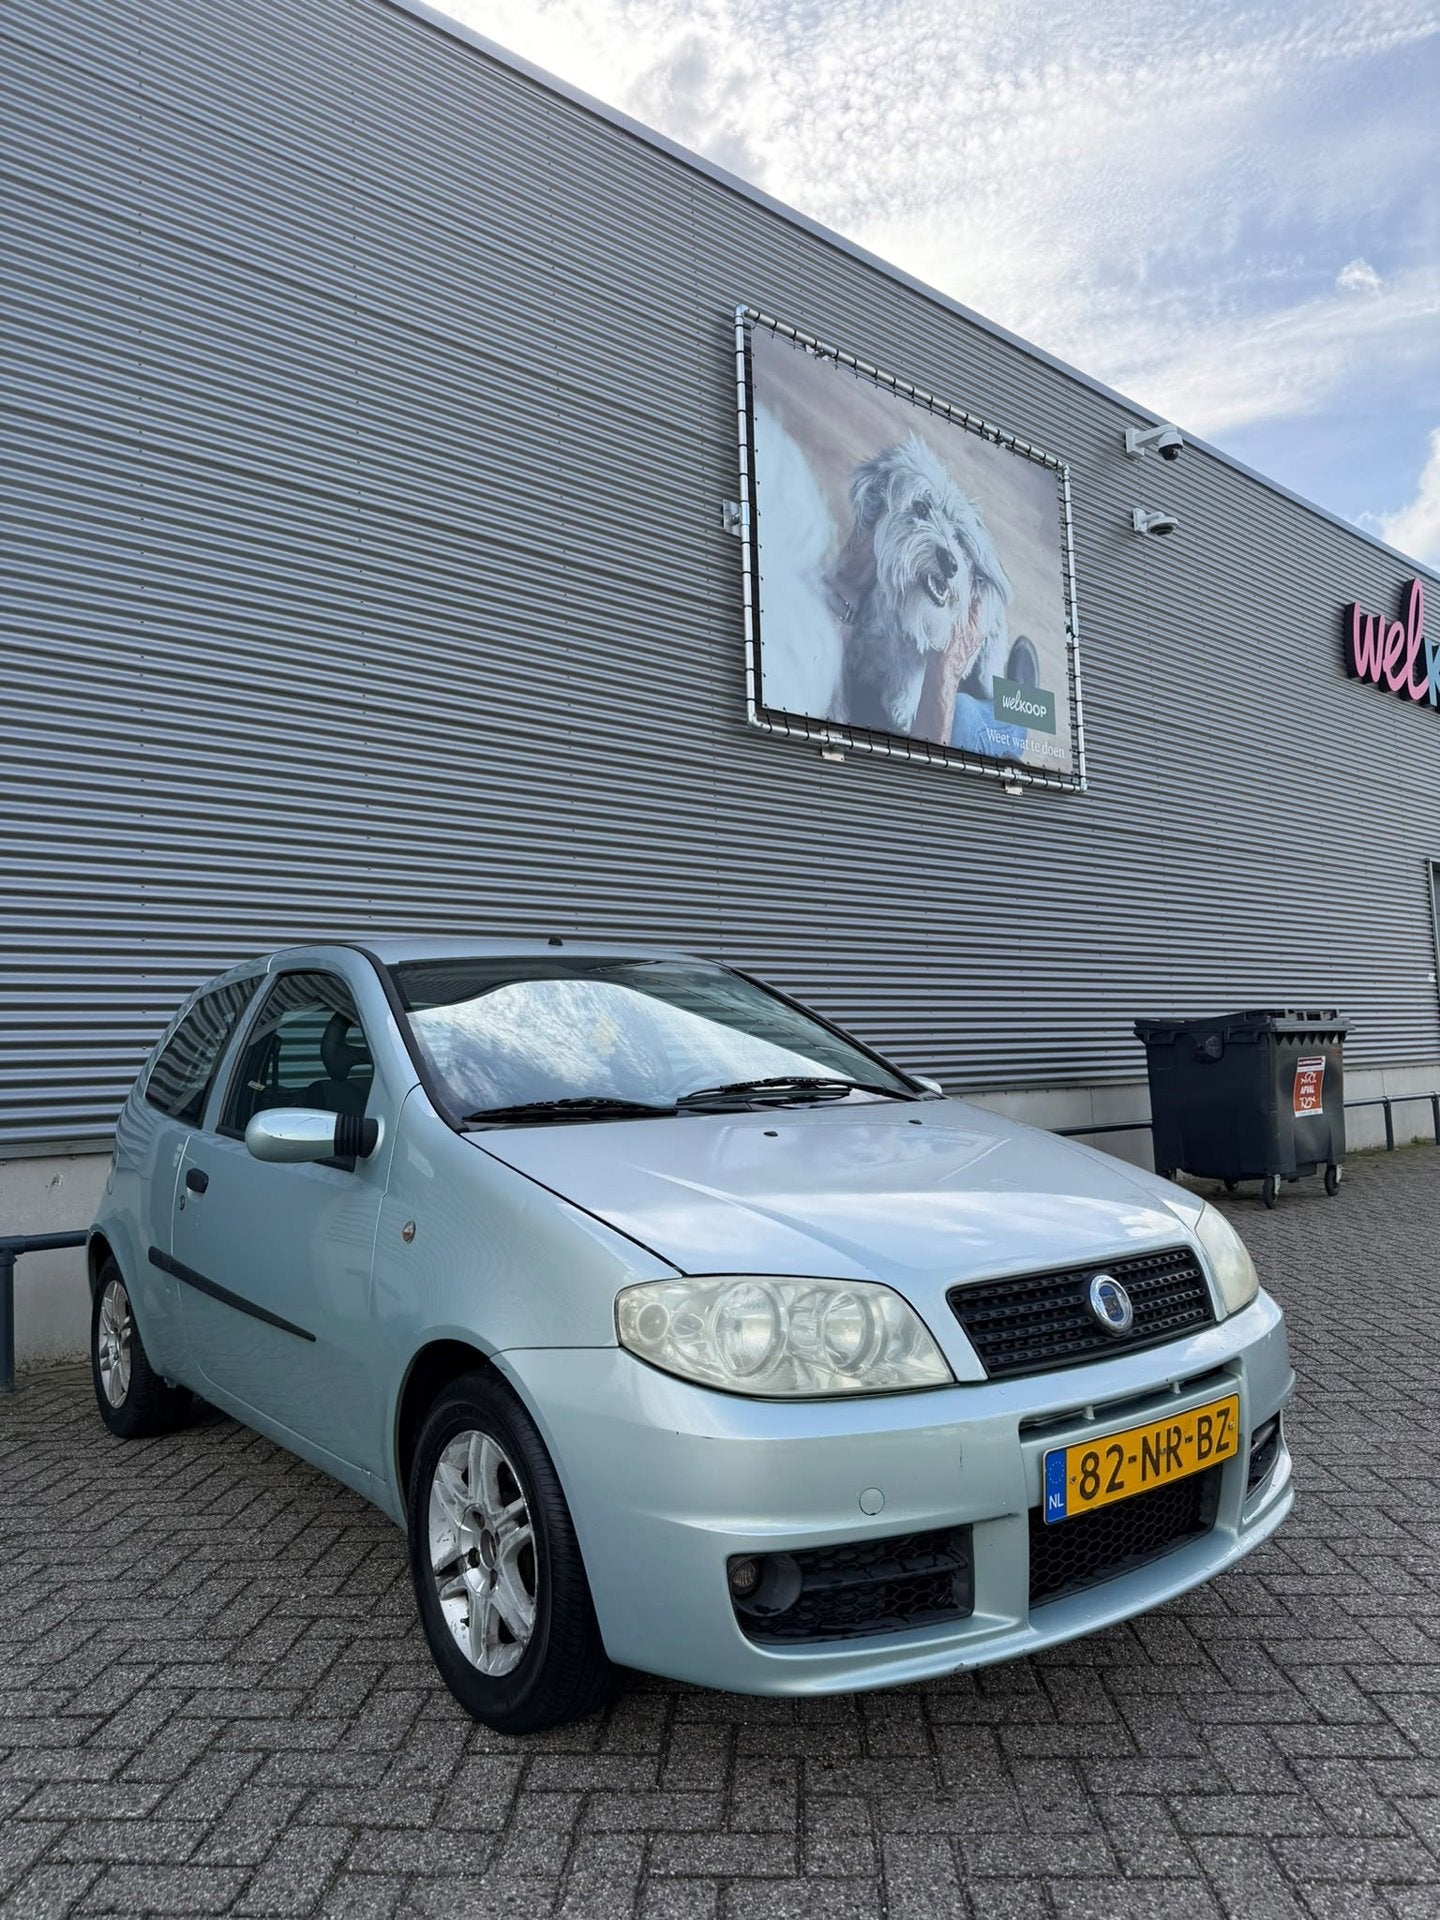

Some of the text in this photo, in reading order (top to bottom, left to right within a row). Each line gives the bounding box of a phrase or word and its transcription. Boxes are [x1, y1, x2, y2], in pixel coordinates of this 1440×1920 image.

[986, 728, 1065, 759] Weet wat te doen
[1079, 1406, 1231, 1501] 82-NR-BZ
[1049, 1492, 1064, 1510] NL
